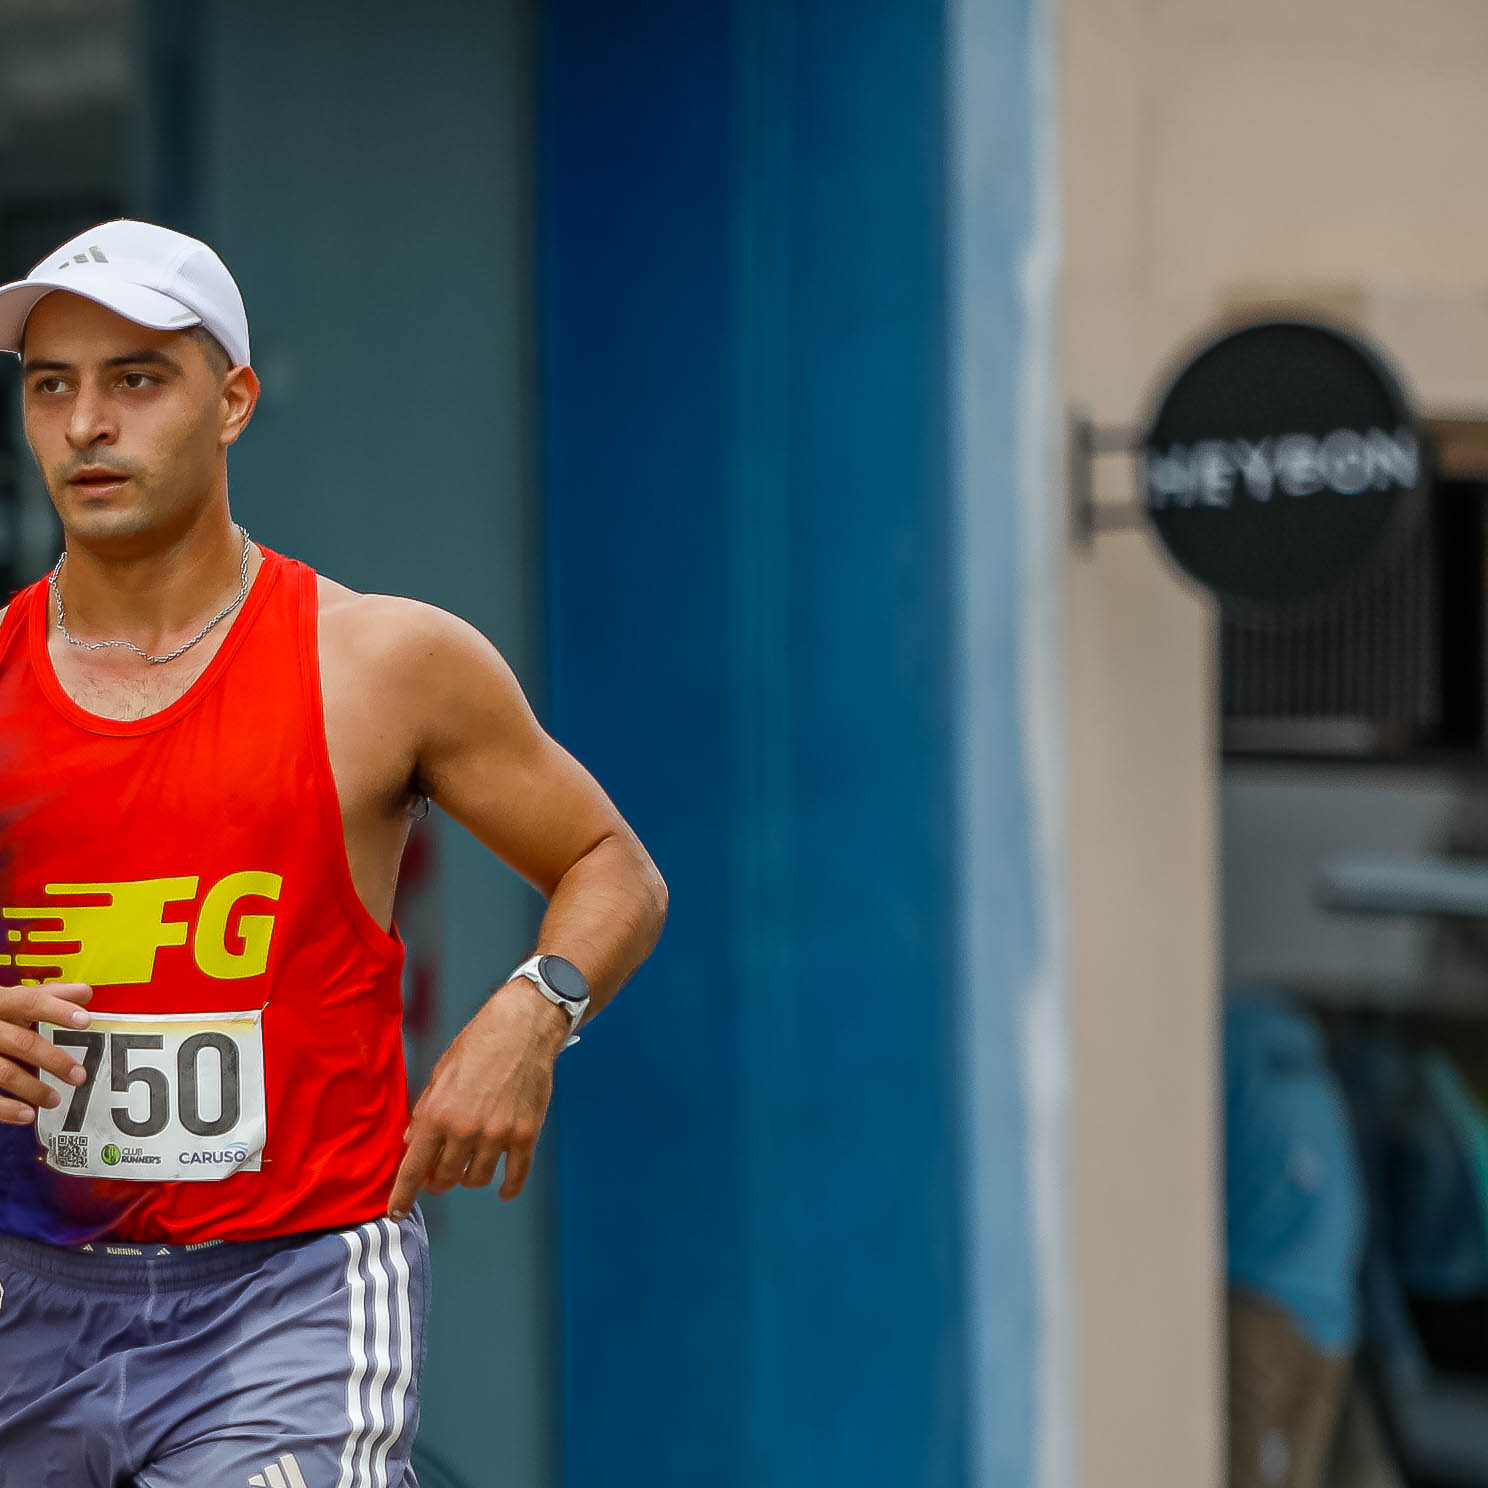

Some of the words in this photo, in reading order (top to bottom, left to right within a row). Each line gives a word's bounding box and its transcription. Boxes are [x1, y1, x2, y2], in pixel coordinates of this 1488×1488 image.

[44, 870, 283, 986] FG
[52, 1030, 241, 1138] 750
[121, 1147, 143, 1156] CLUB
[178, 1150, 247, 1165] CARUSO
